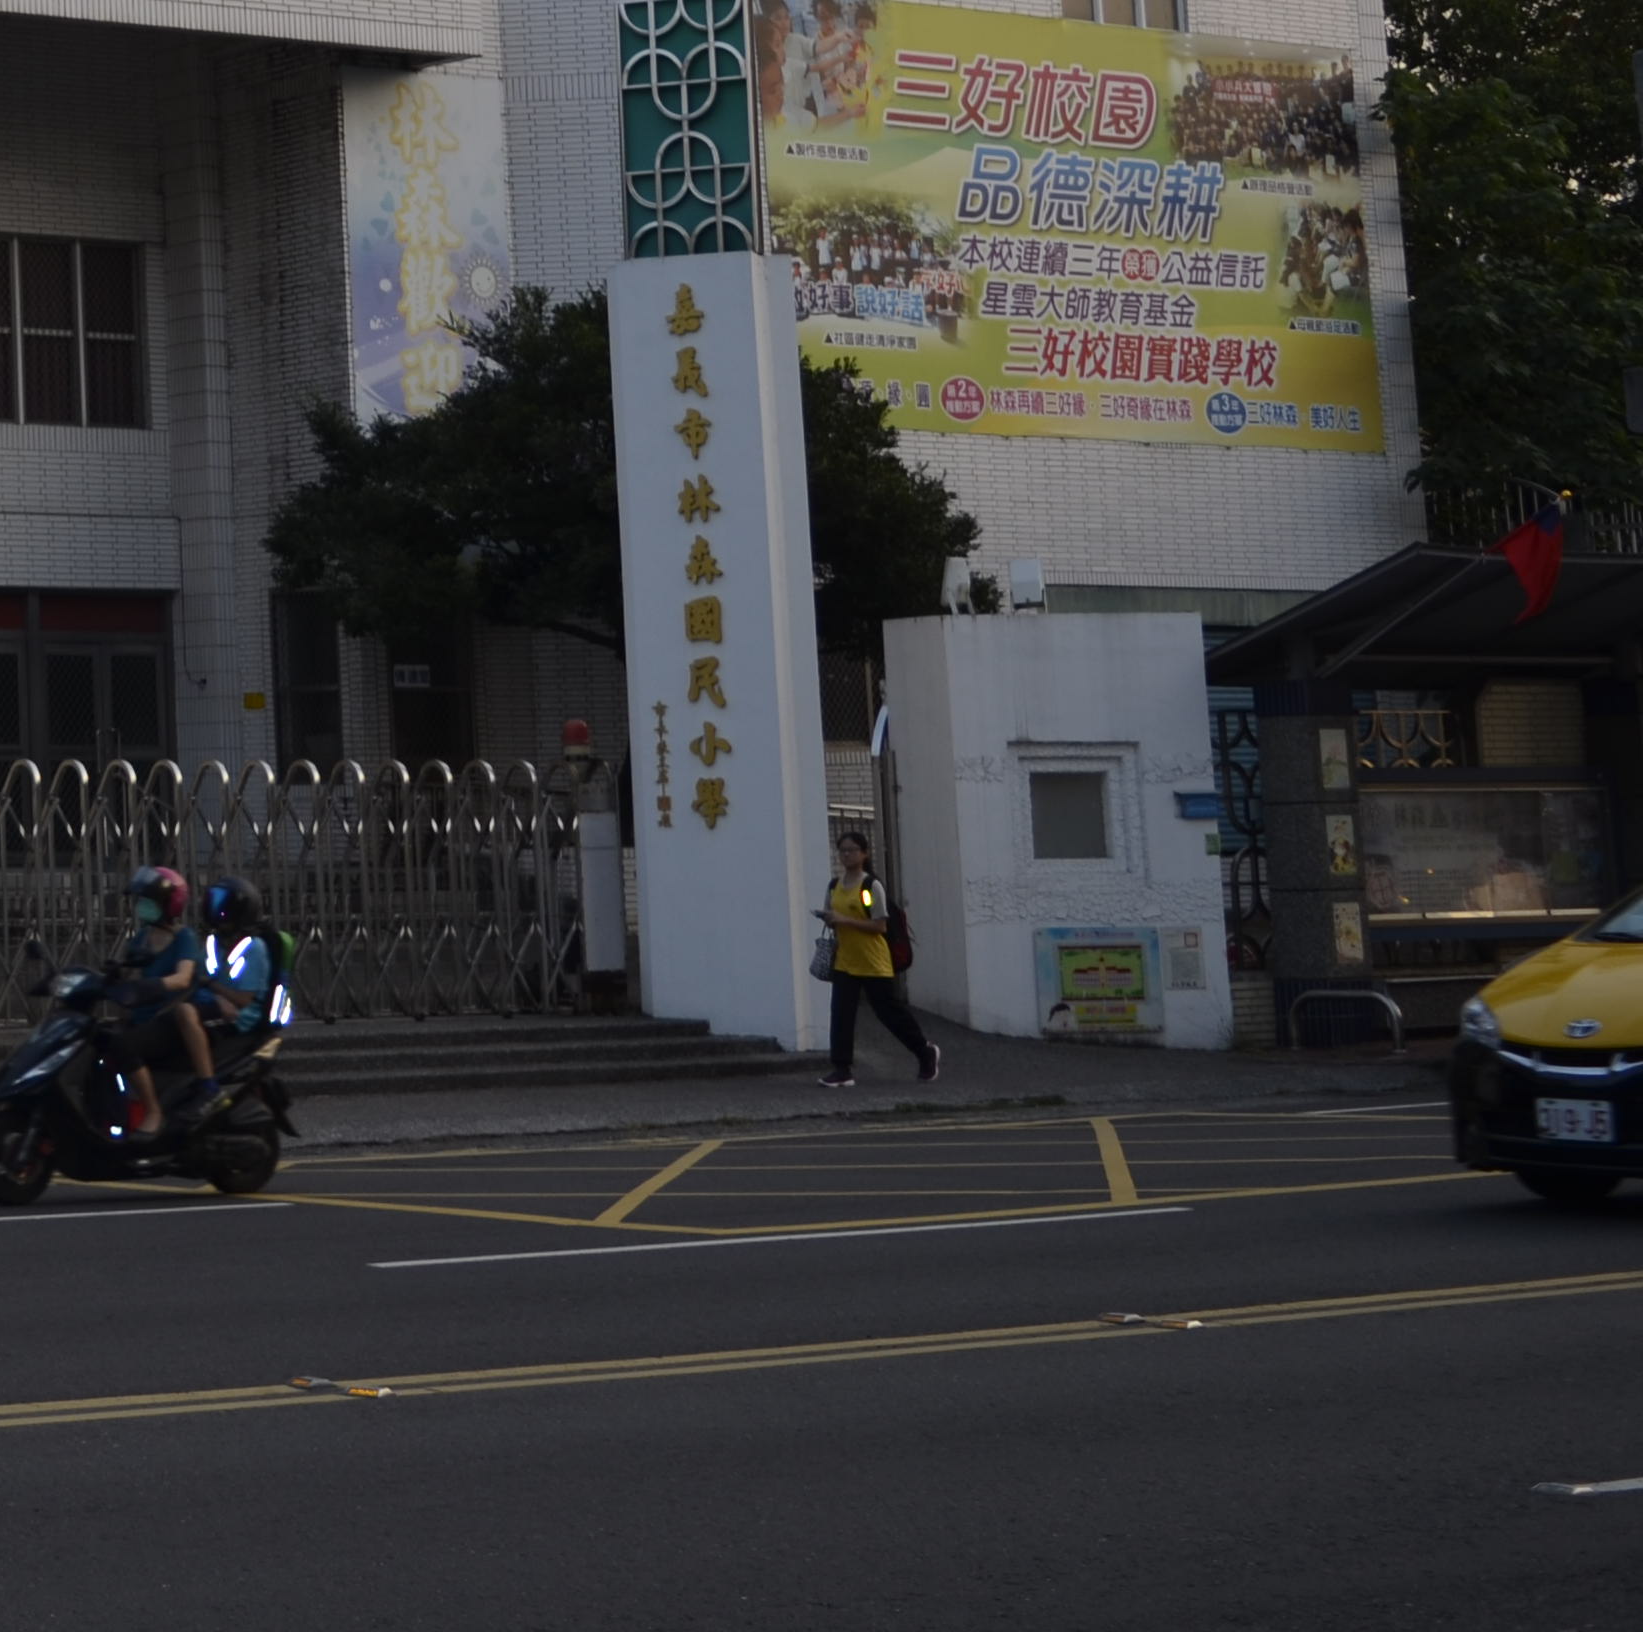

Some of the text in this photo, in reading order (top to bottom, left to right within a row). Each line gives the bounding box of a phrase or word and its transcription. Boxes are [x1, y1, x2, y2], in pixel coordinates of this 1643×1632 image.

[884, 50, 1156, 149] 三好校園
[956, 144, 1224, 242] 品德深耕
[981, 286, 1196, 329] 星雲大師教育基金
[1003, 325, 1277, 389] 三好校園實踐學校
[667, 283, 733, 830] 嘉義市林森國民小學
